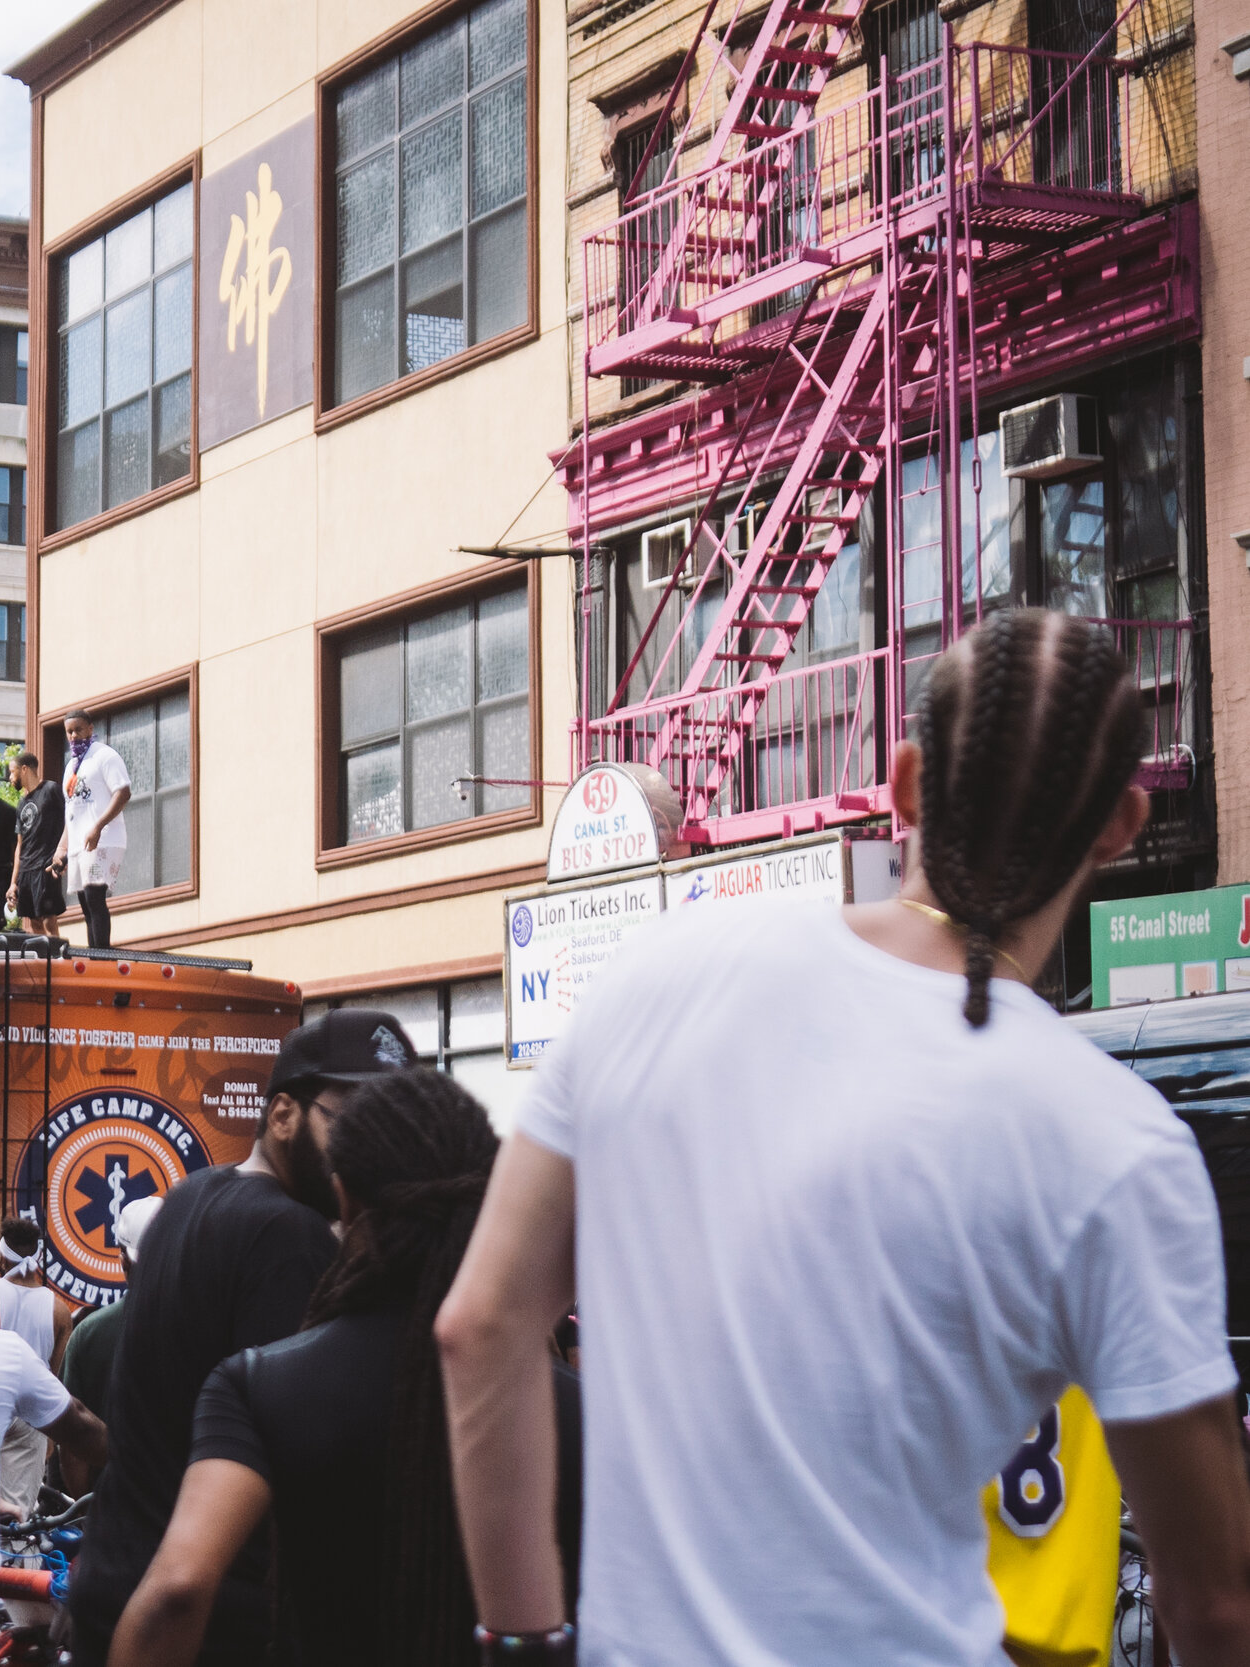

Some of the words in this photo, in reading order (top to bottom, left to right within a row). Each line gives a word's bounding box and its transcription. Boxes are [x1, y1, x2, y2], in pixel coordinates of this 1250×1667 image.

[588, 774, 612, 811] 59
[574, 819, 609, 840] CANAL
[613, 814, 628, 832] ST.
[561, 842, 592, 871] BUS
[602, 832, 646, 863] STOP
[713, 864, 762, 899] JAGUAR
[765, 854, 807, 890] TICKET
[811, 850, 838, 881] INC.
[537, 903, 566, 927] Lion
[569, 896, 620, 921] Tickets
[624, 889, 651, 912] Inc.
[1110, 916, 1126, 943] 55
[1128, 911, 1166, 940] Canal
[1168, 908, 1211, 937] Street
[609, 929, 623, 942] DE
[521, 968, 551, 1003] NY
[78, 1028, 136, 1048] TOGETHER
[137, 1035, 166, 1048] COME
[166, 1036, 190, 1049] JOIN
[191, 1037, 211, 1050] THE
[213, 1036, 281, 1054] PEACEFORCE
[203, 1094, 219, 1105] Text
[221, 1095, 234, 1106] ALL
[236, 1096, 245, 1106] IN
[247, 1096, 253, 1106] 4
[223, 1082, 258, 1094] DONATE
[39, 1104, 87, 1149] LIFE
[91, 1097, 153, 1121] CAMP
[156, 1112, 194, 1157] INC.
[218, 1107, 227, 1117] to
[228, 1107, 262, 1119] 51555
